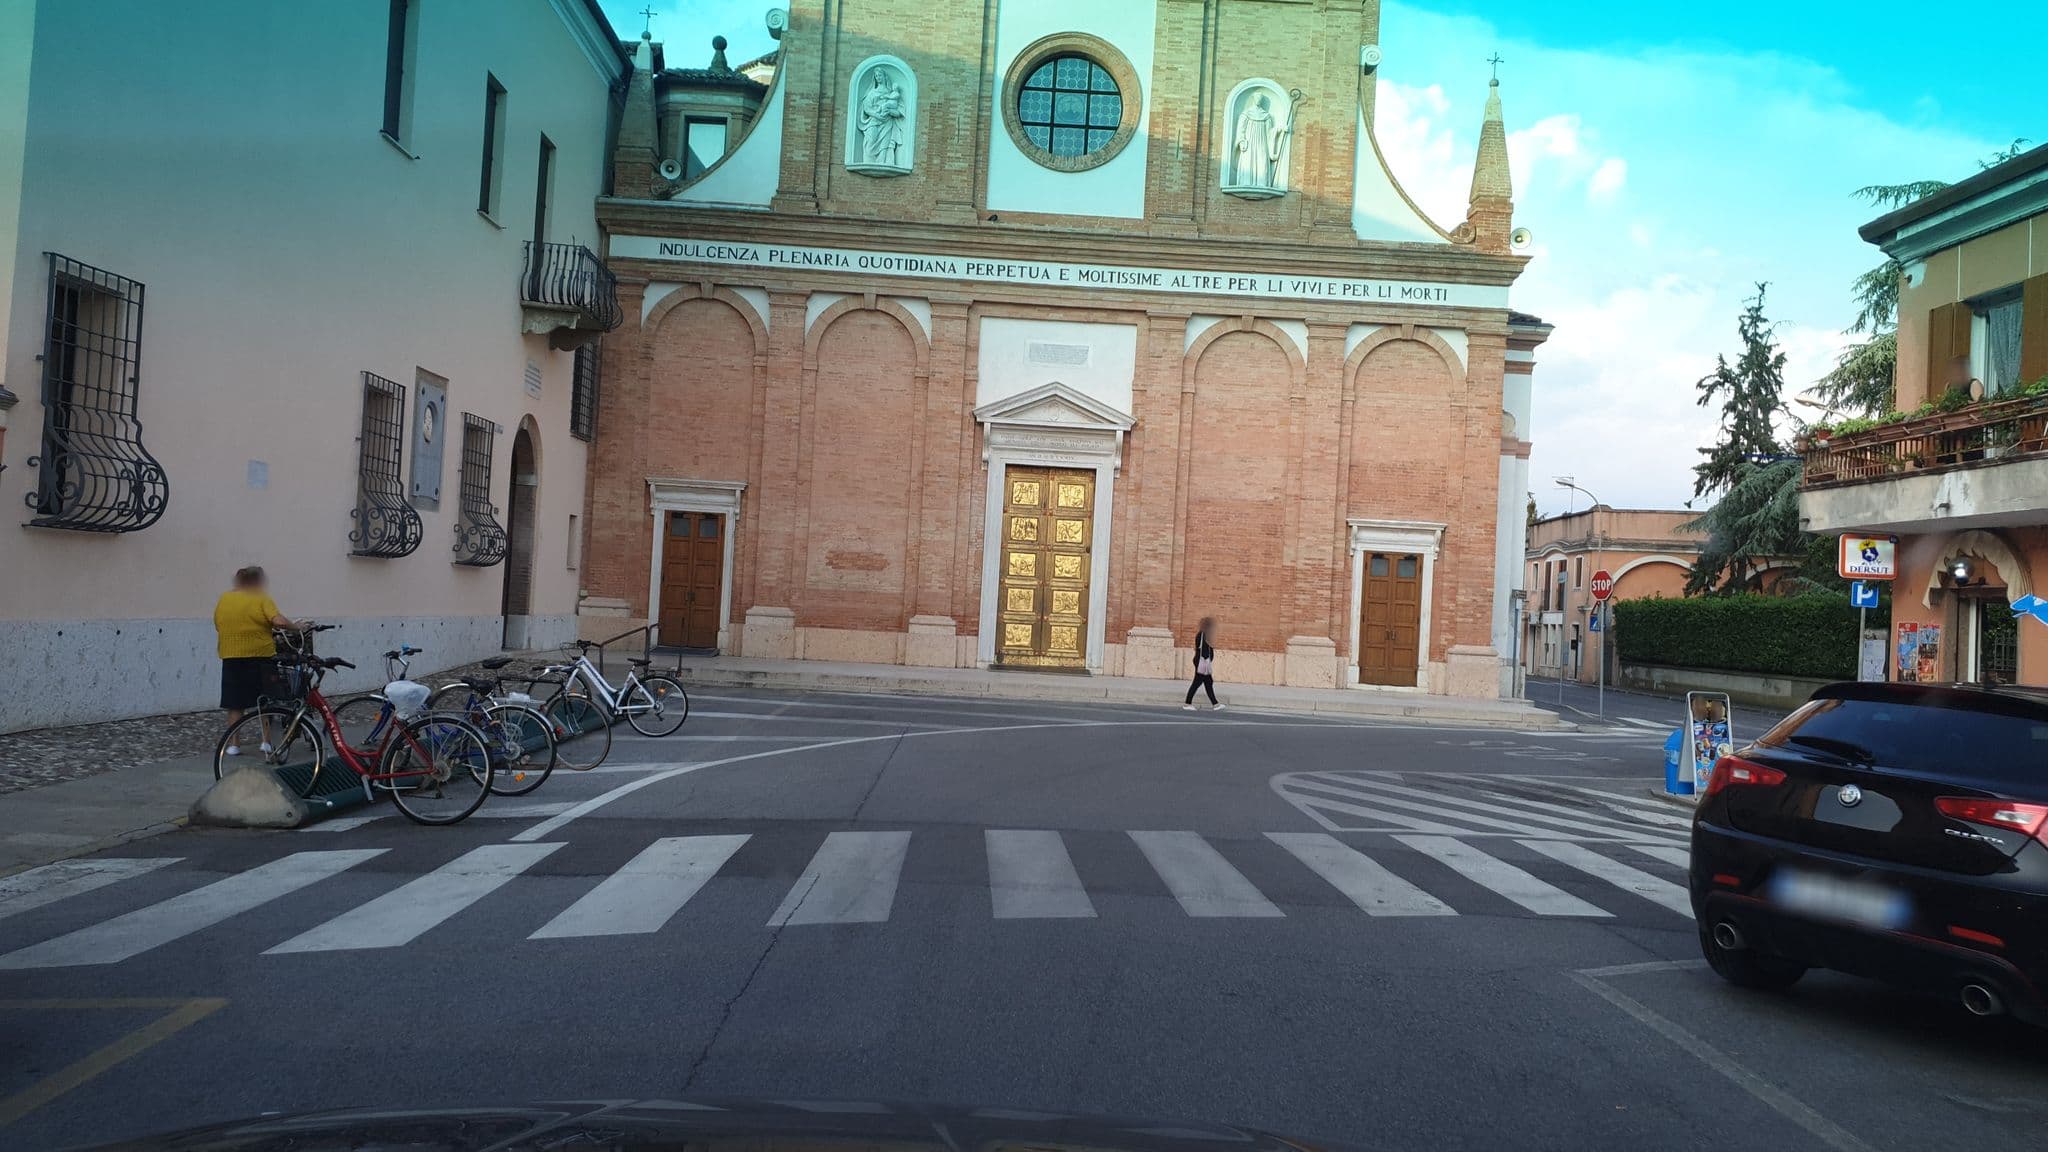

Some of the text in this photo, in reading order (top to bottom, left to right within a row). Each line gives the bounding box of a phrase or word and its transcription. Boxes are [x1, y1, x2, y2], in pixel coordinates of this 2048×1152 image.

[659, 242, 1448, 301] INDULGENZA PLENARIA QUOTIDIANA PERPETUA E MOLTISSIME ALTRE PER LI VIVI E PER LI MORTI
[1849, 565, 1889, 575] DERSUT
[1592, 579, 1611, 592] STOP
[1856, 584, 1874, 605] P
